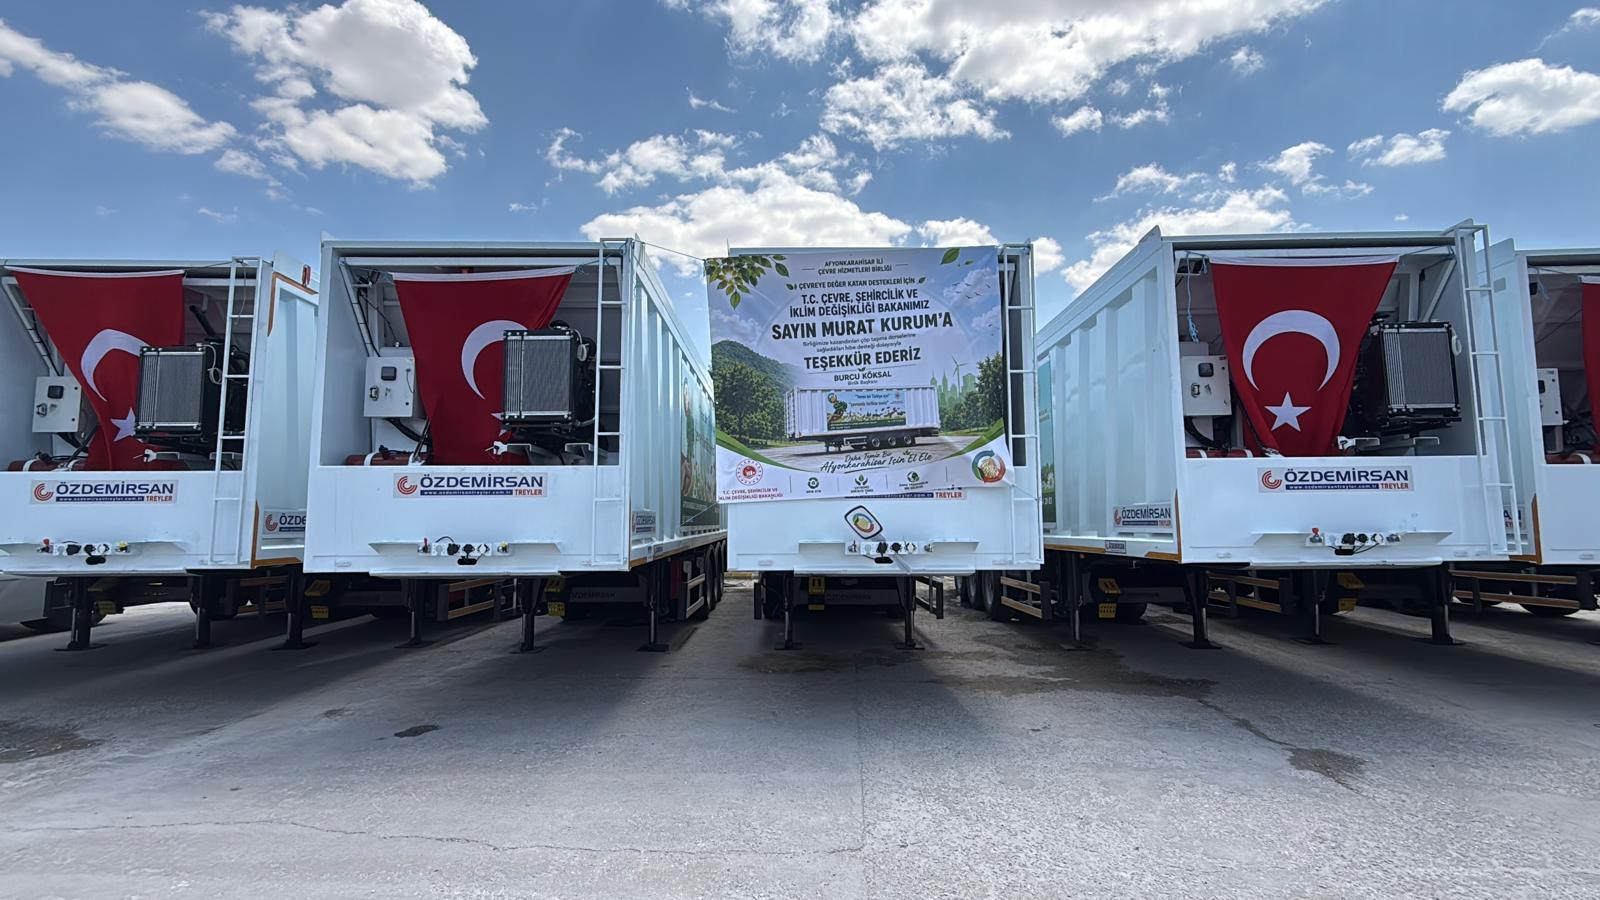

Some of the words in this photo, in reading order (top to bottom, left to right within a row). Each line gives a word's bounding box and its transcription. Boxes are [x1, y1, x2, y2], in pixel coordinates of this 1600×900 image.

[818, 268, 836, 276] ÇEVRE
[798, 282, 826, 291] ÇEVREYE
[827, 280, 847, 288] DEĞER
[847, 279, 867, 287] KATAN
[868, 277, 903, 286] DESTEKLERİ
[801, 294, 819, 304] T.C.
[821, 292, 854, 306] ÇEVRE,
[855, 287, 904, 304] ŞEHİRCİLİK
[906, 288, 918, 299] VE
[789, 304, 816, 318] İKLİM
[818, 301, 875, 317] DEĞİŞİKLİĞİ
[877, 299, 929, 313] BAKANIMIZ
[772, 323, 817, 340] SAYIN
[822, 319, 875, 337] MURAT
[881, 312, 953, 332] KURUM'A
[804, 351, 871, 370] TEŞEKKÜR
[875, 346, 921, 363] EDERİZ
[834, 373, 860, 381] BURCU
[862, 371, 892, 379] KÖKSAL
[420, 473, 543, 488] ÖZDEMİRSAN
[1284, 467, 1408, 482] ÖZDEMİRSAN
[56, 481, 174, 495] ÖZDEMİRSAN
[935, 491, 962, 499] TREYLER
[1121, 505, 1171, 519] ÖZDEMİRSAN
